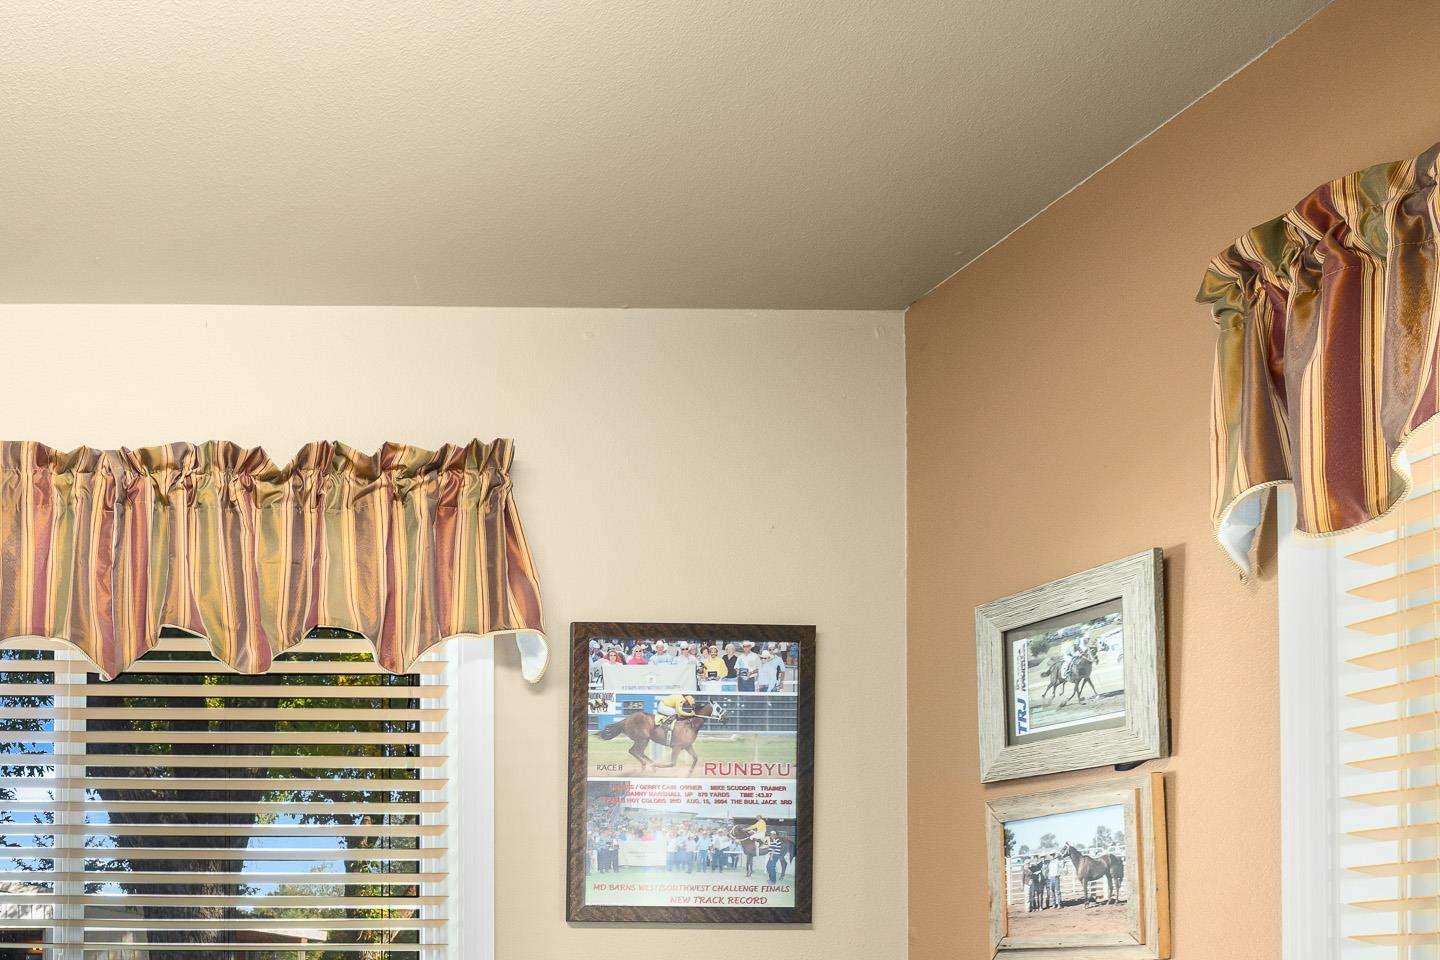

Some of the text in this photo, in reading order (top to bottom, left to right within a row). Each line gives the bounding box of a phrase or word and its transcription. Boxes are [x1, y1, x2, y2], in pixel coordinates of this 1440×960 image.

[1017, 698, 1027, 734] TRJ
[704, 762, 791, 776] RUNBYU
[712, 884, 759, 892] CHALLENGE
[761, 885, 790, 893] FINALS
[670, 896, 768, 904] NEW TRACK RECORD
